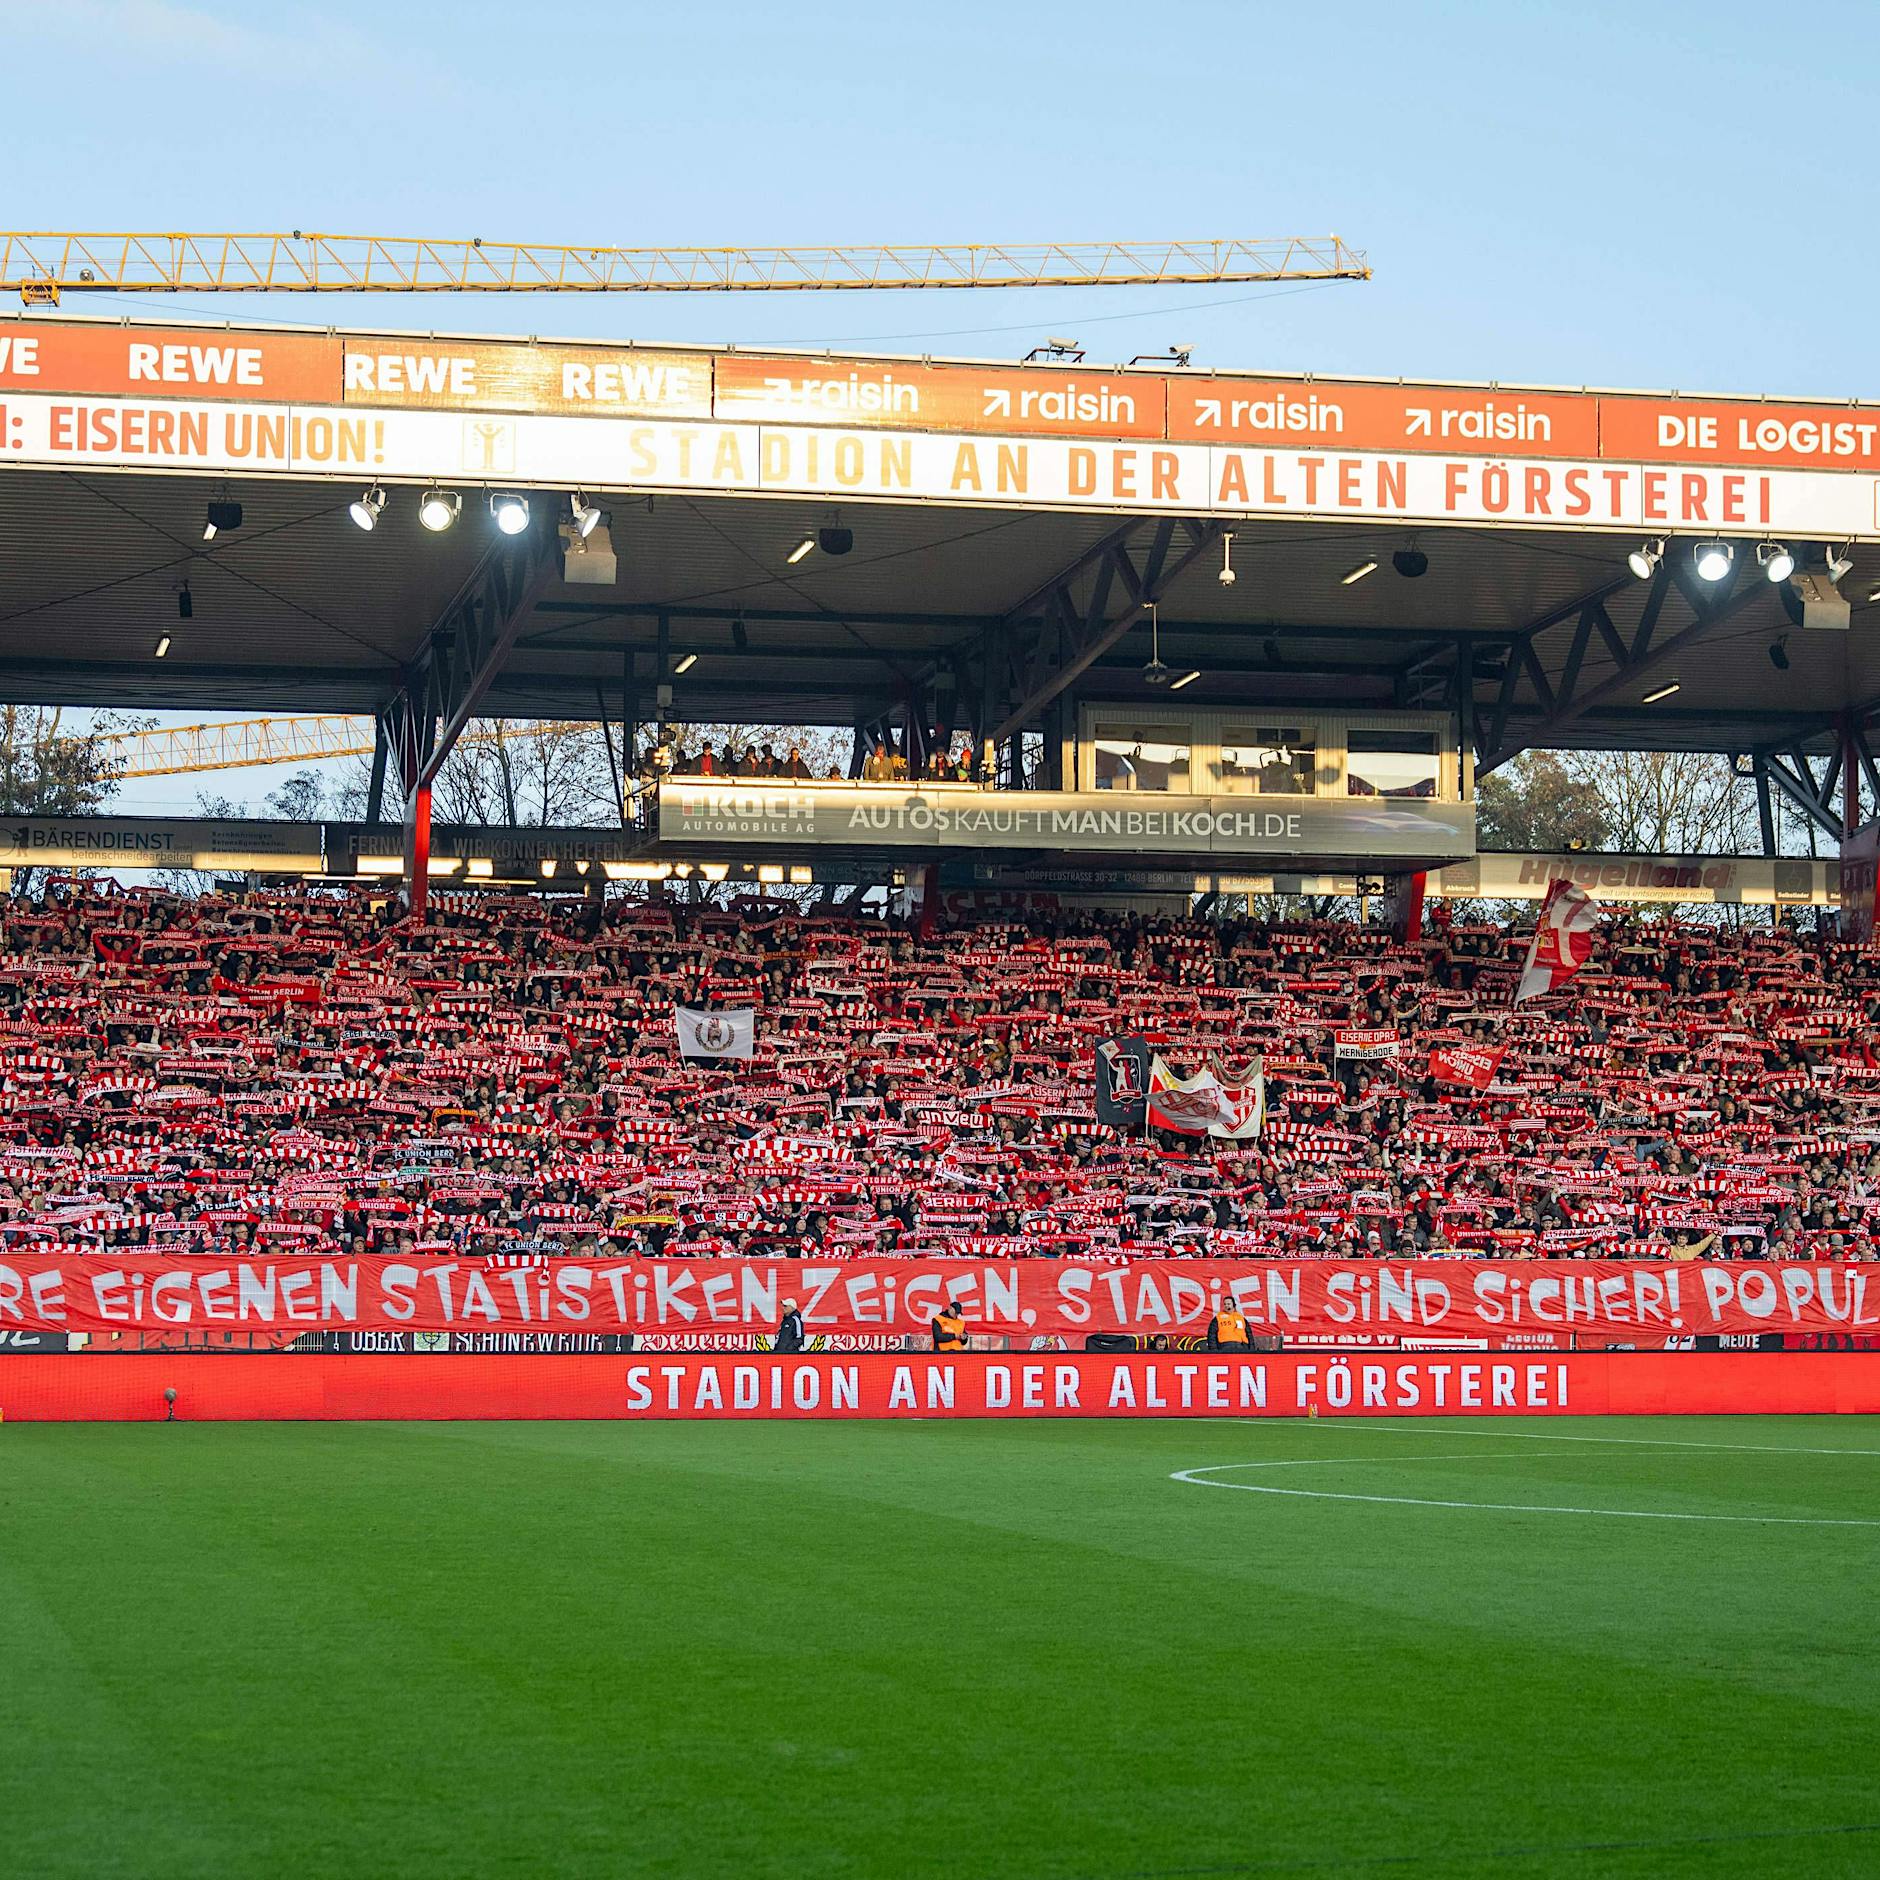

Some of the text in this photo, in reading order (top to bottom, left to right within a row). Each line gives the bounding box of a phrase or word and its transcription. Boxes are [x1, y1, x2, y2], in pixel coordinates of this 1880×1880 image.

[129, 344, 263, 385] REWE
[346, 354, 475, 395] REWE
[562, 362, 690, 402] REWE
[802, 372, 918, 413] raisin
[1021, 382, 1135, 424] raisin
[1231, 393, 1343, 432] raisin
[1440, 402, 1550, 441] raisin
[49, 405, 208, 457] EISERN
[225, 413, 385, 464] UNION!
[1659, 415, 1878, 457] DIE LOGIST
[630, 426, 1771, 524] STADION AN DER ALTEN FÖRSTEREI
[709, 795, 815, 819] KOCH
[682, 820, 815, 833] AUTOMOBILE AG
[33, 827, 174, 850] BÄRENDIENST
[453, 838, 488, 857] WIR
[1518, 859, 1732, 889] Hügelland
[1632, 891, 1673, 900] entsorgen
[242, 986, 304, 996] UNION BERLIN
[1199, 989, 1235, 998] UNIONER
[1592, 1001, 1614, 1010] Union
[1615, 1004, 1641, 1015] Berlin
[1374, 1031, 1396, 1042] OPAS
[309, 1049, 334, 1057] EISERN
[911, 1092, 934, 1100] UNION
[1034, 1088, 1093, 1098] EISERN UNION
[181, 1098, 218, 1106] UNIONER
[992, 1106, 1026, 1115] UNIONER
[560, 1131, 593, 1139] UNIONER
[405, 1150, 431, 1158] UNION
[1480, 1154, 1512, 1162] UNIONER
[610, 1167, 646, 1176] UNIONER
[1084, 1166, 1106, 1175] UNION
[355, 1175, 423, 1189] FC BERLIN
[1747, 1187, 1768, 1195] UNION
[200, 1204, 213, 1212] FC
[923, 1214, 959, 1222] Grenzenlos
[505, 1242, 514, 1250] FC
[675, 1243, 712, 1251] UNIONER
[1701, 1266, 1879, 1327] POPUL
[1718, 1334, 1761, 1349] MEUTE
[627, 1356, 1567, 1409] STADION AN DER ALTEN FÖRSTEREI
